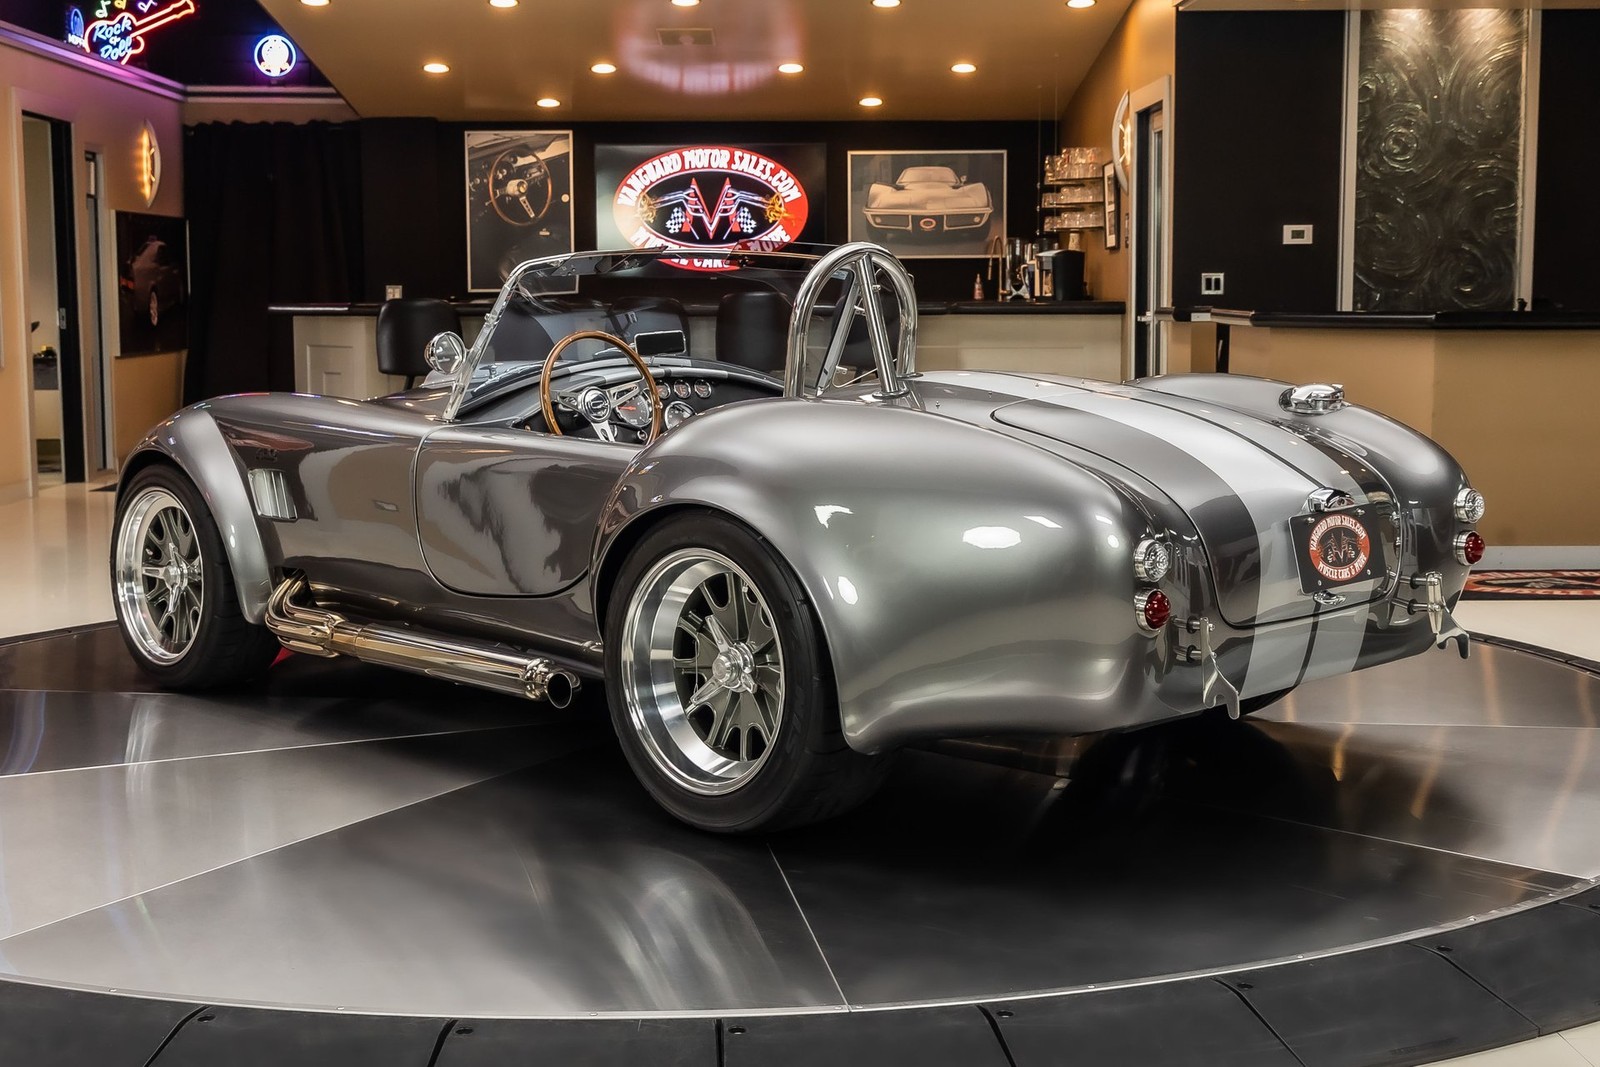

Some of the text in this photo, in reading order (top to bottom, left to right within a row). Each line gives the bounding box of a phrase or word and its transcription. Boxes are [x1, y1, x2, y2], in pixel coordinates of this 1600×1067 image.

[93, 15, 132, 42] Rock
[616, 148, 802, 207] VANGUARD MOTOR SALES.COM
[1310, 519, 1328, 551] VANGUARD
[1326, 515, 1342, 528] MOTOR
[1317, 561, 1338, 579] MUSCLE
[1338, 567, 1351, 579] CARS
